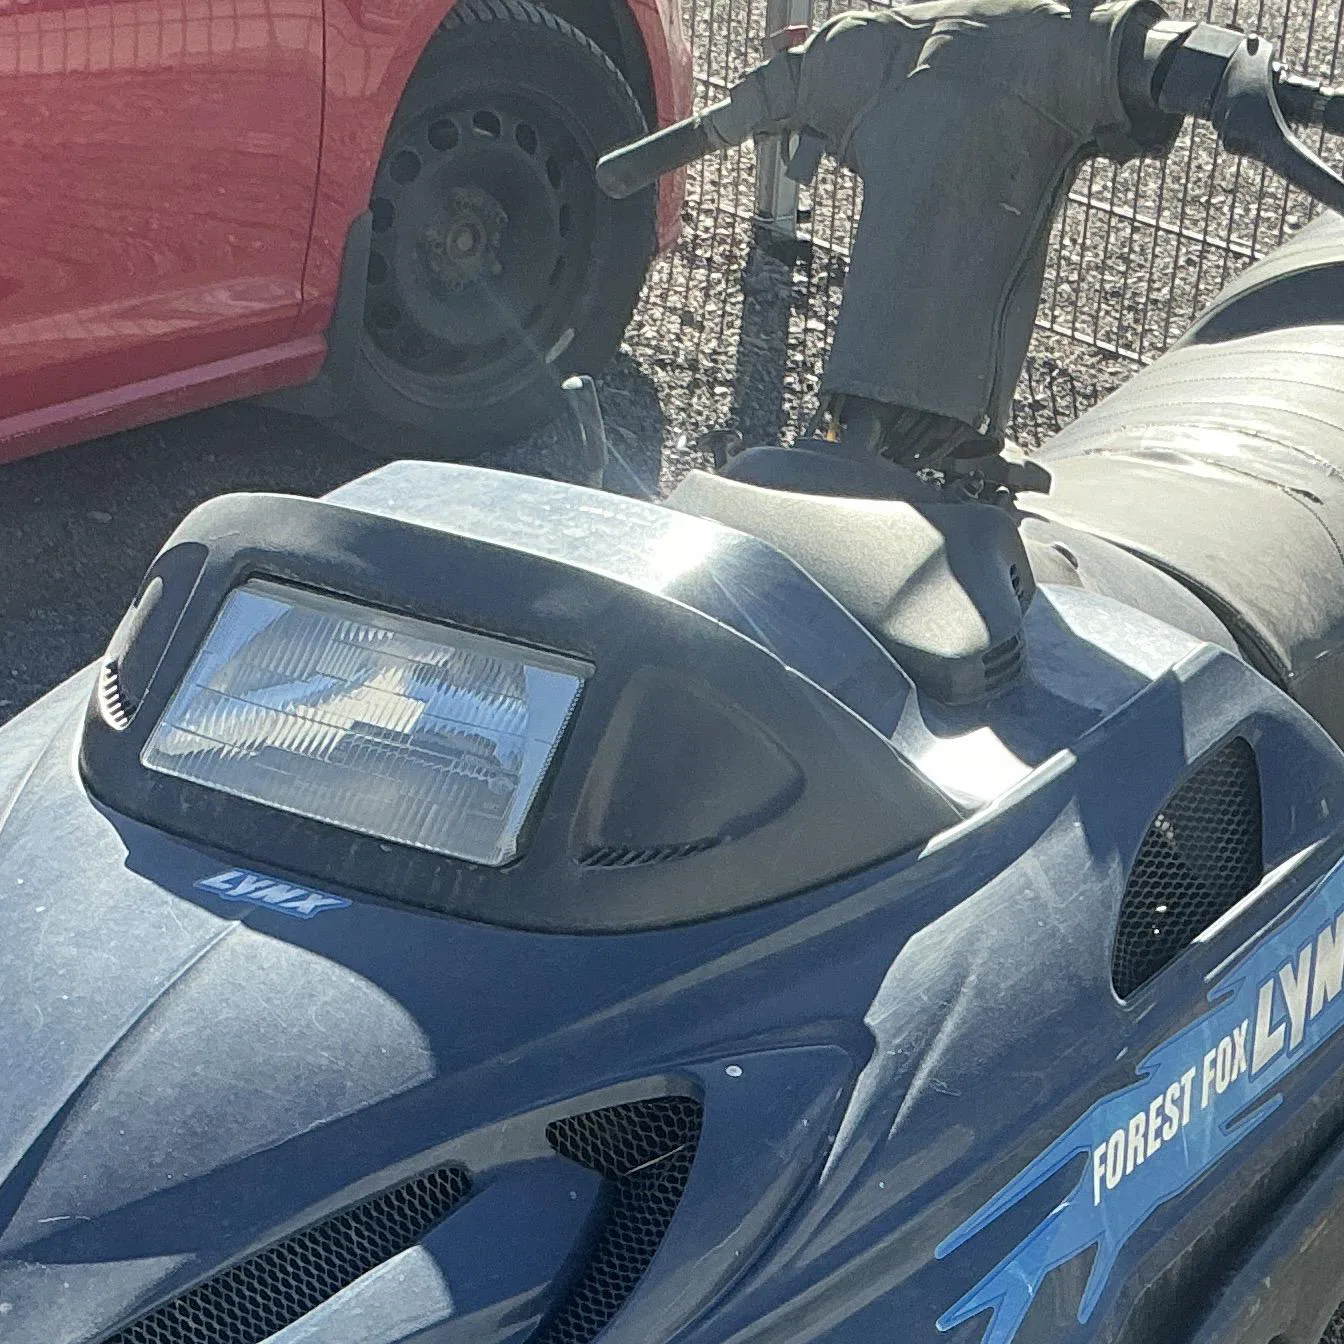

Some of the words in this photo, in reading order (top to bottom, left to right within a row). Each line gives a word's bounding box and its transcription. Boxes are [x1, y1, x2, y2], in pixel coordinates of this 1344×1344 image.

[199, 870, 343, 914] LYNX
[1092, 1066, 1196, 1206] FOREST
[1201, 1019, 1249, 1110] FOX
